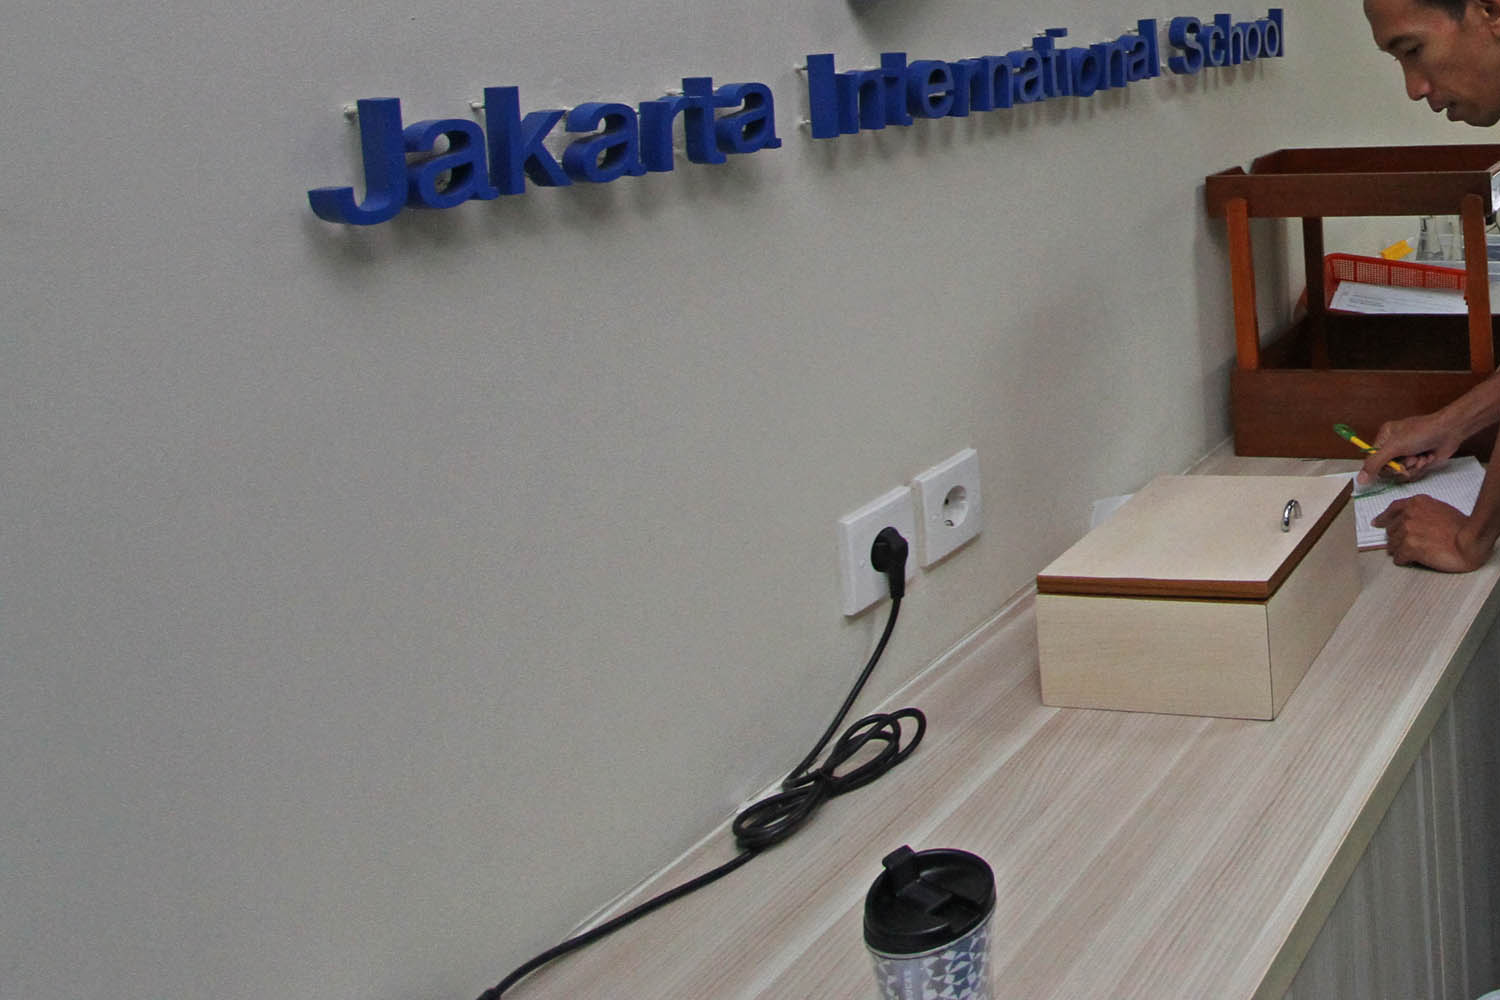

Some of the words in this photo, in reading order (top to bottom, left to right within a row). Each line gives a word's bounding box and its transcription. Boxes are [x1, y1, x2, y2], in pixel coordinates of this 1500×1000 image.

[308, 76, 781, 225] Jakarta
[806, 19, 1159, 138] International
[1168, 8, 1284, 75] School
